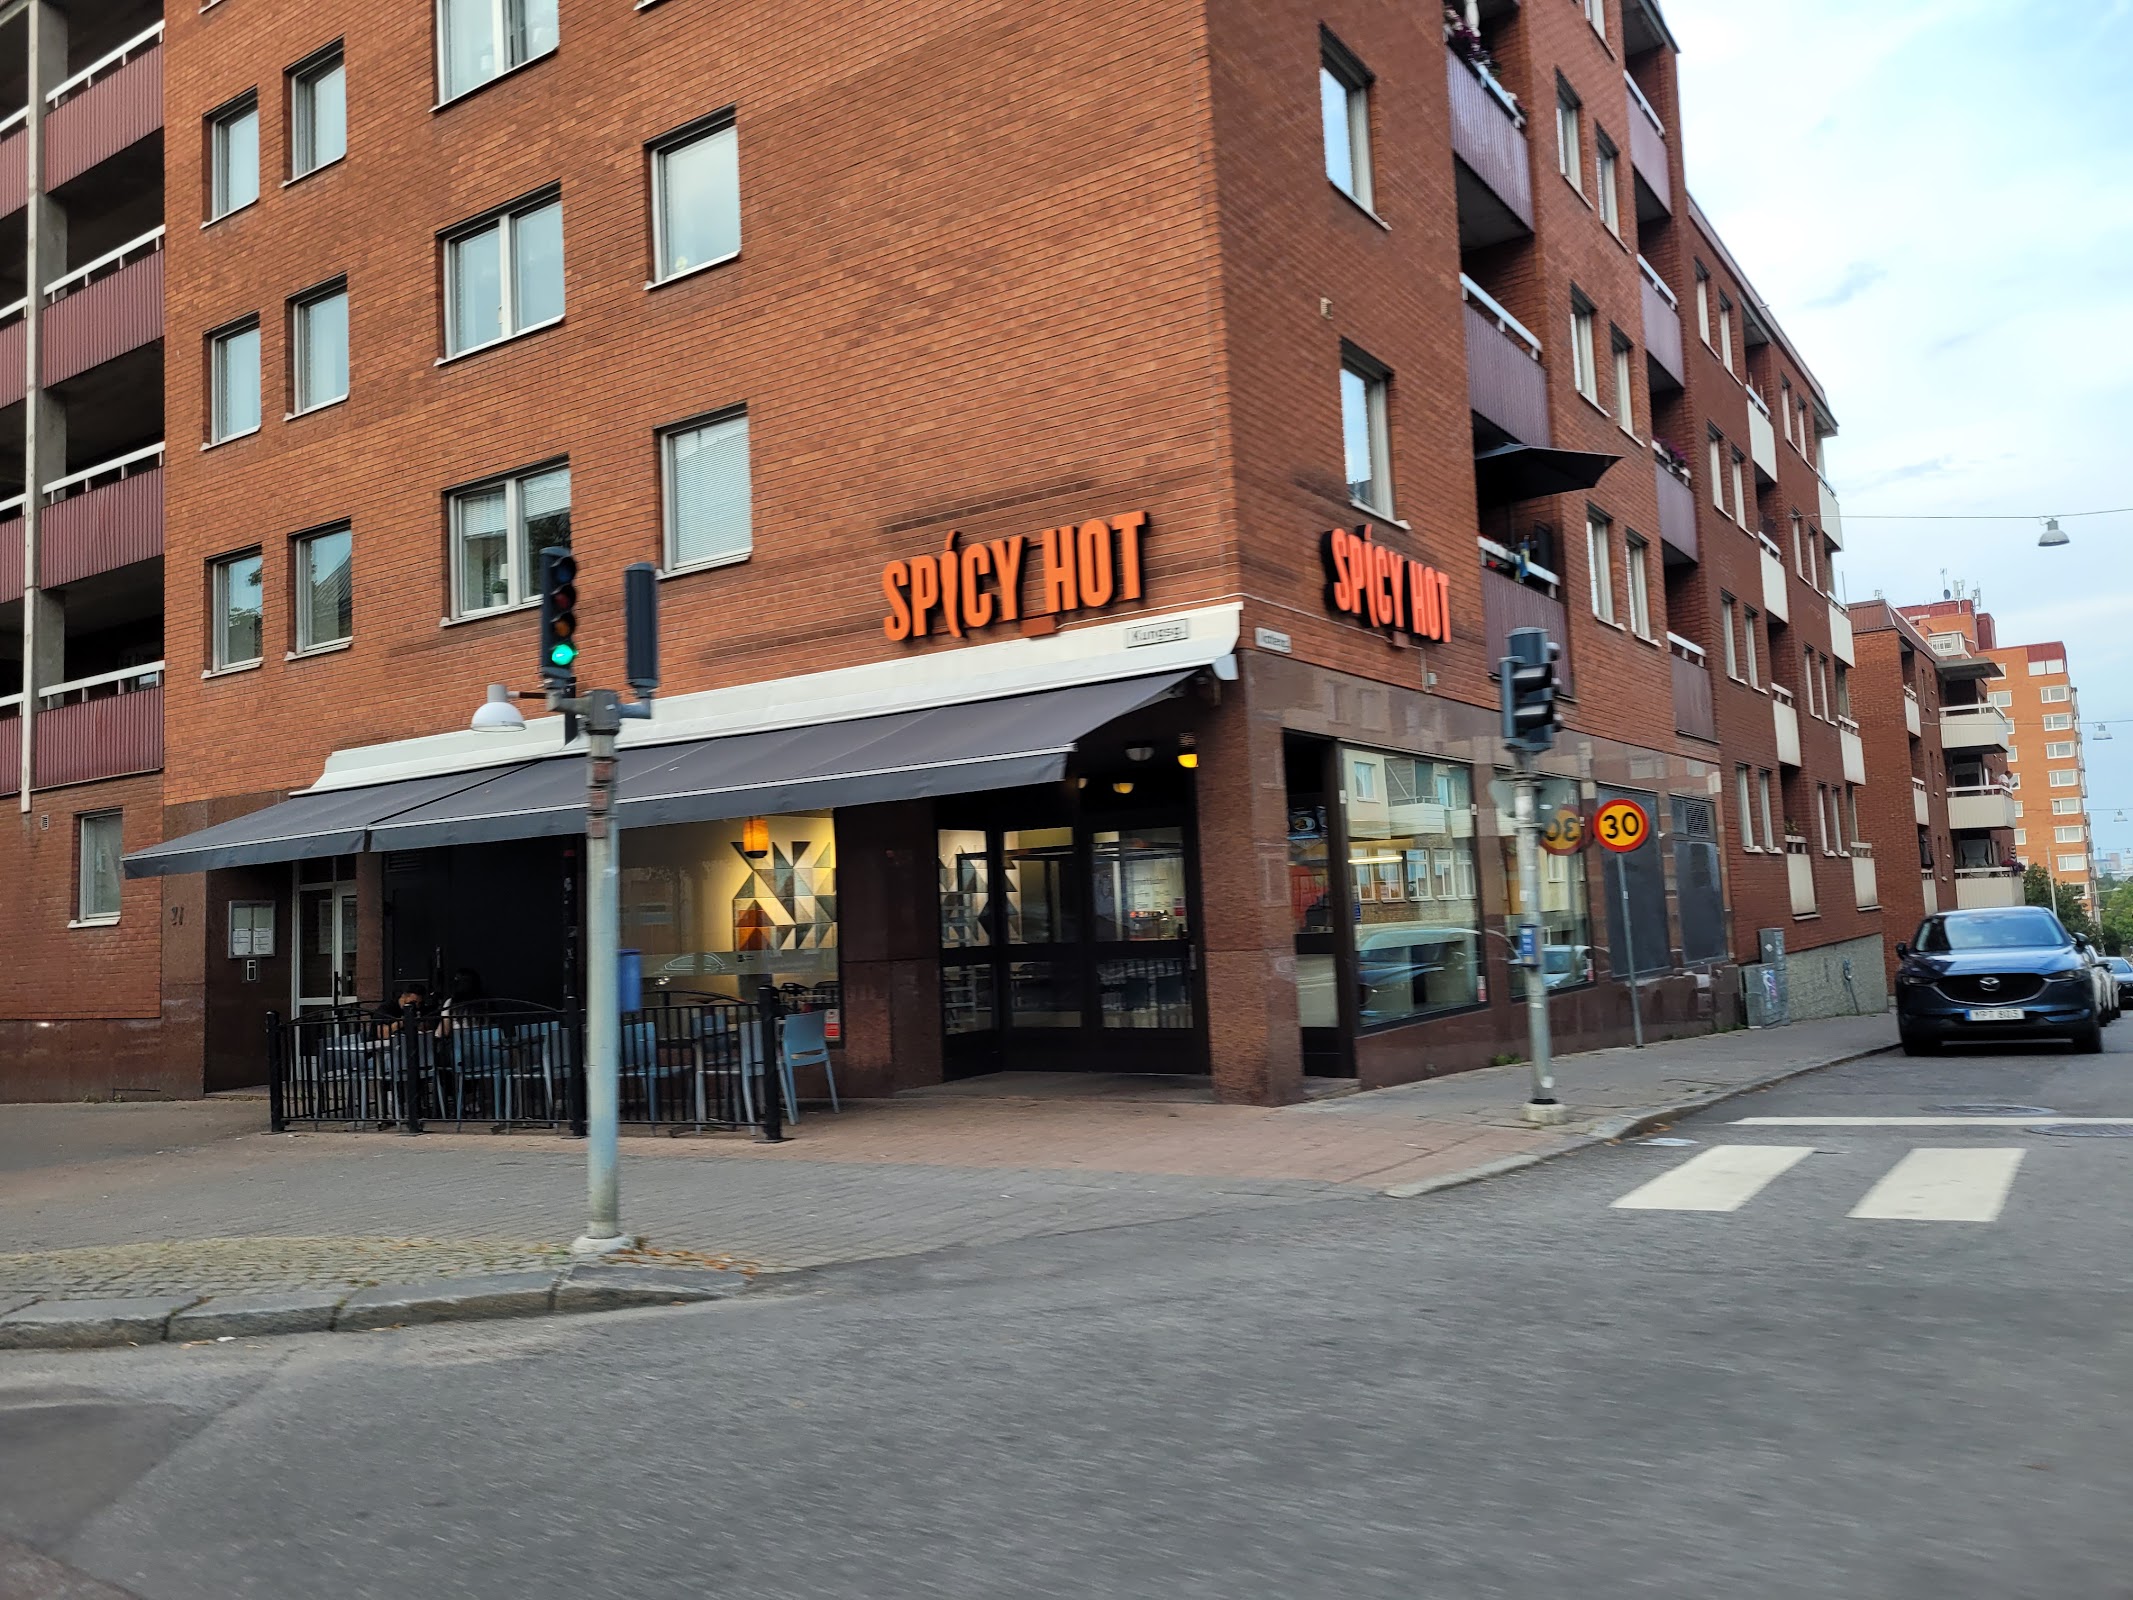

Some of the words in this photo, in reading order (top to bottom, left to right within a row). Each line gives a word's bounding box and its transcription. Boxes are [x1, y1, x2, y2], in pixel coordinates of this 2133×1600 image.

[1042, 510, 1146, 613] HOT
[1409, 560, 1452, 643] HOT
[1603, 811, 1640, 839] 30
